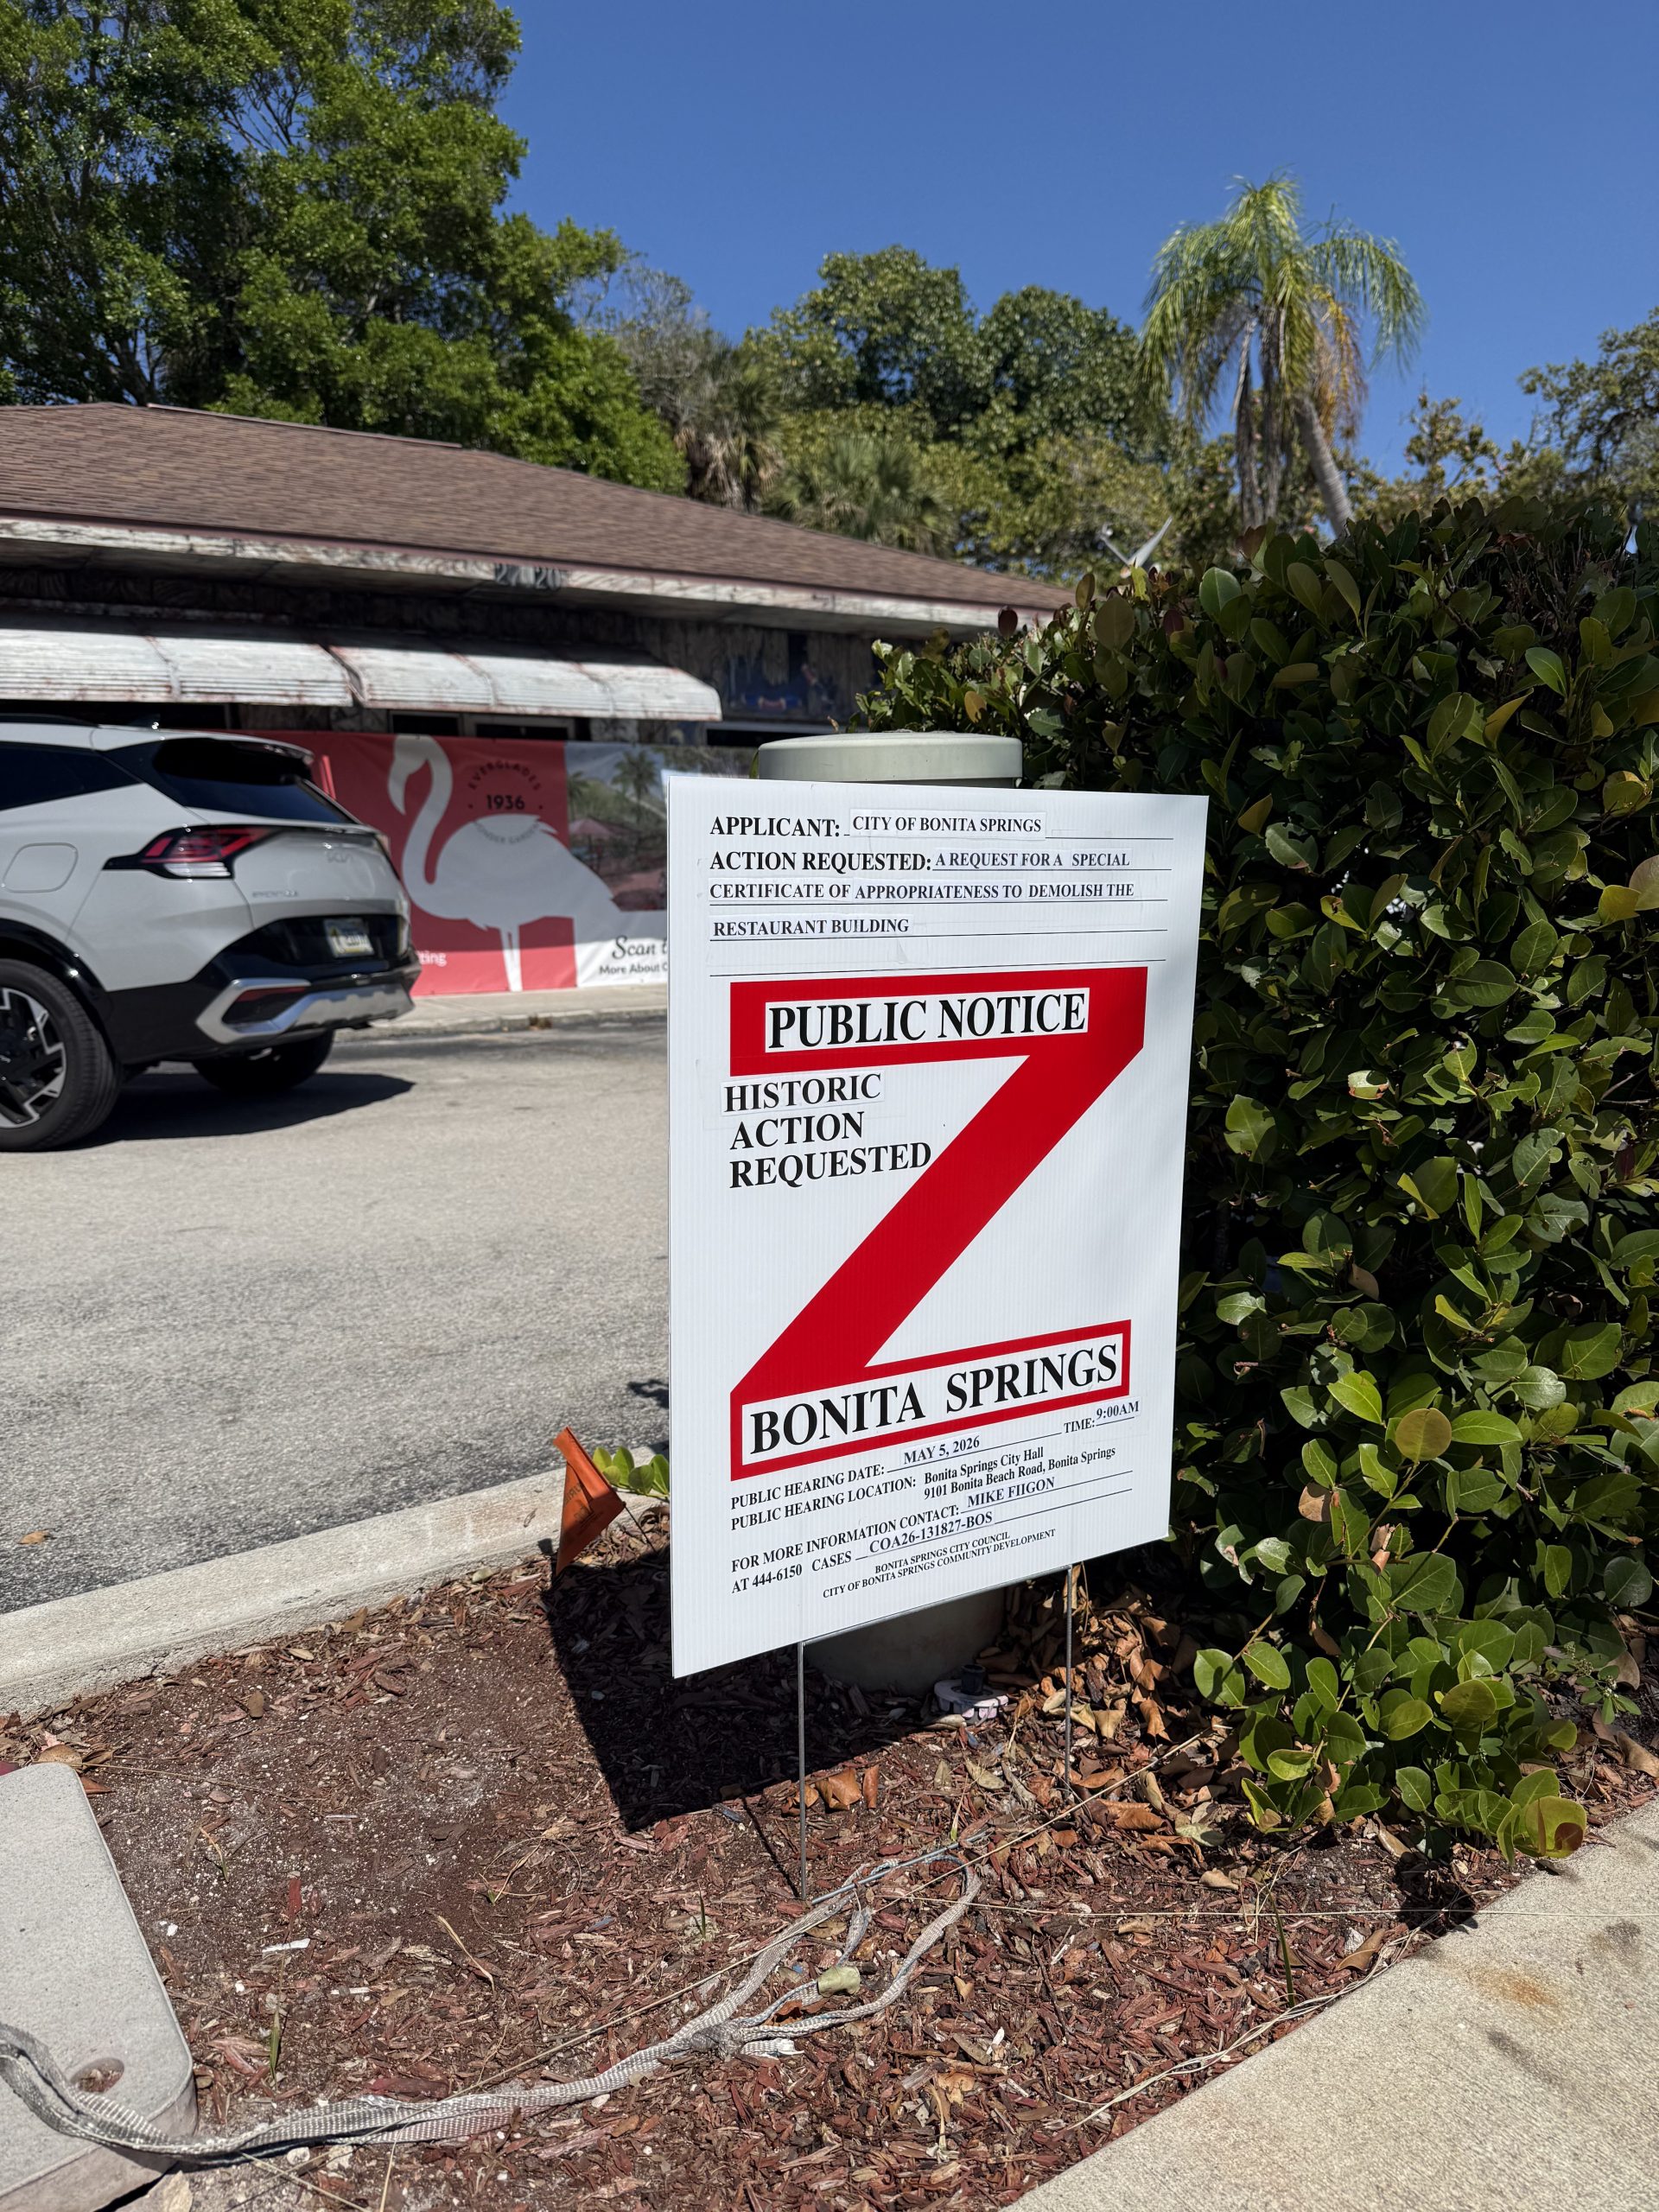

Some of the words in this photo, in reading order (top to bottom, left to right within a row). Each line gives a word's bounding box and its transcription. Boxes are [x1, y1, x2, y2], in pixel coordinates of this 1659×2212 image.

[468, 761, 541, 790] EVERGLADES
[486, 794, 525, 810] 1936
[710, 817, 839, 836] APPLICANT:
[854, 817, 891, 830] CITY
[896, 817, 916, 830] OF
[921, 818, 976, 830] BONITA
[981, 818, 1040, 831] SPRINGS
[710, 852, 796, 870] ACTION
[803, 853, 931, 874] REQUESTED:
[936, 854, 945, 865] A
[949, 853, 1018, 869] REQUEST
[1022, 854, 1050, 866] FOR
[1054, 855, 1062, 866] A
[1072, 854, 1129, 866] SPECIAL
[710, 884, 823, 898] CERTIFICATE
[830, 885, 850, 897] OF
[855, 886, 998, 899] APPROPRIATENESS
[1003, 886, 1021, 898] TO
[1029, 885, 1102, 897] DEMOLISH
[1107, 884, 1133, 896] THE
[612, 935, 655, 959] Scan
[715, 920, 827, 936] RESTAURANT
[832, 919, 908, 932] BUILDING
[600, 964, 626, 975] More
[630, 963, 659, 974] About
[769, 1001, 927, 1048] PUBLIC
[937, 994, 1085, 1038] NOTICE
[725, 1074, 880, 1112] HISTORIC
[730, 1111, 863, 1149] ACTION
[730, 1142, 931, 1187] REQUESTED
[751, 1382, 925, 1454] BONITA
[947, 1344, 1117, 1412] SPRINGS
[732, 1487, 780, 1510] PUBLIC
[785, 1473, 844, 1497] HEARING
[849, 1465, 884, 1482] DATE:
[905, 1446, 935, 1465] MAY
[939, 1444, 950, 1457] 5,
[953, 1437, 980, 1452] 2026
[1065, 1418, 1094, 1433] TIME:
[1096, 1402, 1139, 1419] 9:00AM
[925, 1484, 946, 1499] 9101
[951, 1478, 982, 1493] Bonita
[987, 1469, 1014, 1484] Beach
[1019, 1463, 1045, 1478] Road,
[1049, 1457, 1077, 1470] Bonita
[1082, 1448, 1115, 1464] Springs
[732, 1508, 780, 1530] PUBLIC
[785, 1494, 844, 1517] HEARING
[849, 1477, 915, 1502] LOCATION:
[925, 1469, 957, 1484] Bonita
[961, 1460, 997, 1478] Springs
[1001, 1454, 1020, 1469] City
[1024, 1447, 1043, 1462] Hall
[733, 1555, 759, 1572] FOR
[764, 1543, 803, 1564] MORE
[807, 1520, 897, 1553] INFORMATION
[900, 1505, 959, 1529] CONTACT:
[969, 1489, 1004, 1506] MIKE
[733, 1578, 749, 1592] AT
[753, 1564, 802, 1586] 444-6150
[812, 1551, 851, 1571] CASES
[870, 1512, 992, 1552] COA26-131827-BOS
[823, 1585, 845, 1598] CITY
[848, 1581, 860, 1591] OF
[862, 1573, 895, 1587] BONITA
[898, 1561, 935, 1577] SPRINGS
[938, 1548, 989, 1567] COMMUNITY
[994, 1529, 1055, 1551] DEVELOPMENT
[876, 1559, 908, 1573] BONITA
[911, 1548, 947, 1565] SPRINGS
[950, 1542, 969, 1554] CITY
[972, 1532, 1010, 1548] COUNCIL
